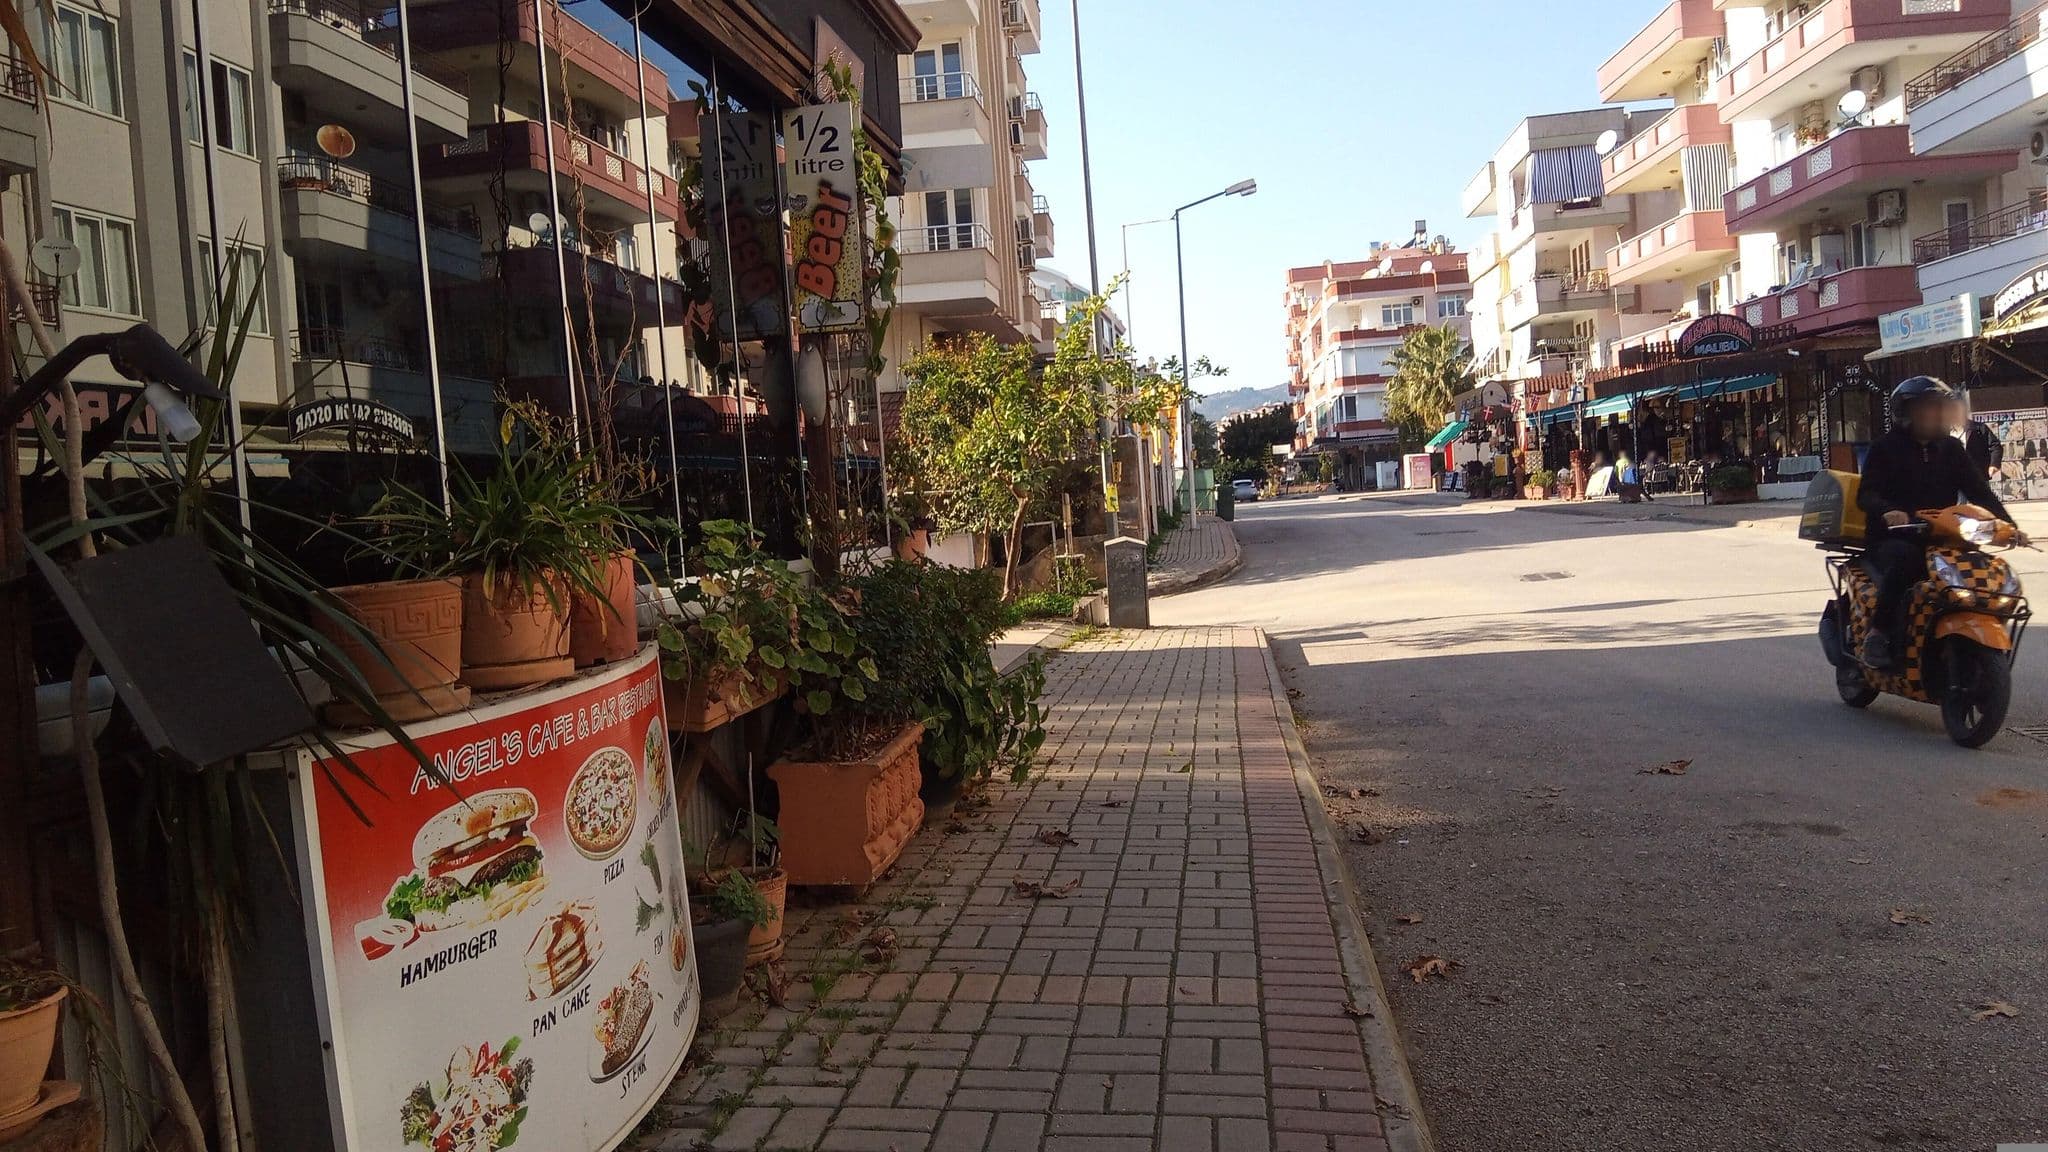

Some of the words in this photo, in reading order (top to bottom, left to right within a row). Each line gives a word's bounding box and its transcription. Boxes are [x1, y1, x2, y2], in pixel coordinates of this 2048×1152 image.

[790, 111, 839, 157] 1/2
[794, 158, 844, 176] litre
[797, 183, 851, 299] Beer
[1694, 340, 1740, 356] MALIBU
[1974, 412, 2014, 423] UNISEX
[411, 730, 523, 795] ANGEL'S
[527, 713, 574, 758] CAFE
[577, 709, 589, 739] &
[591, 696, 618, 735] BAR
[604, 858, 625, 885] PIZZA
[400, 928, 497, 988] HAMBURGER
[533, 1006, 558, 1037] PAN
[562, 984, 591, 1019] CAKE
[620, 1054, 647, 1099] STEAK
